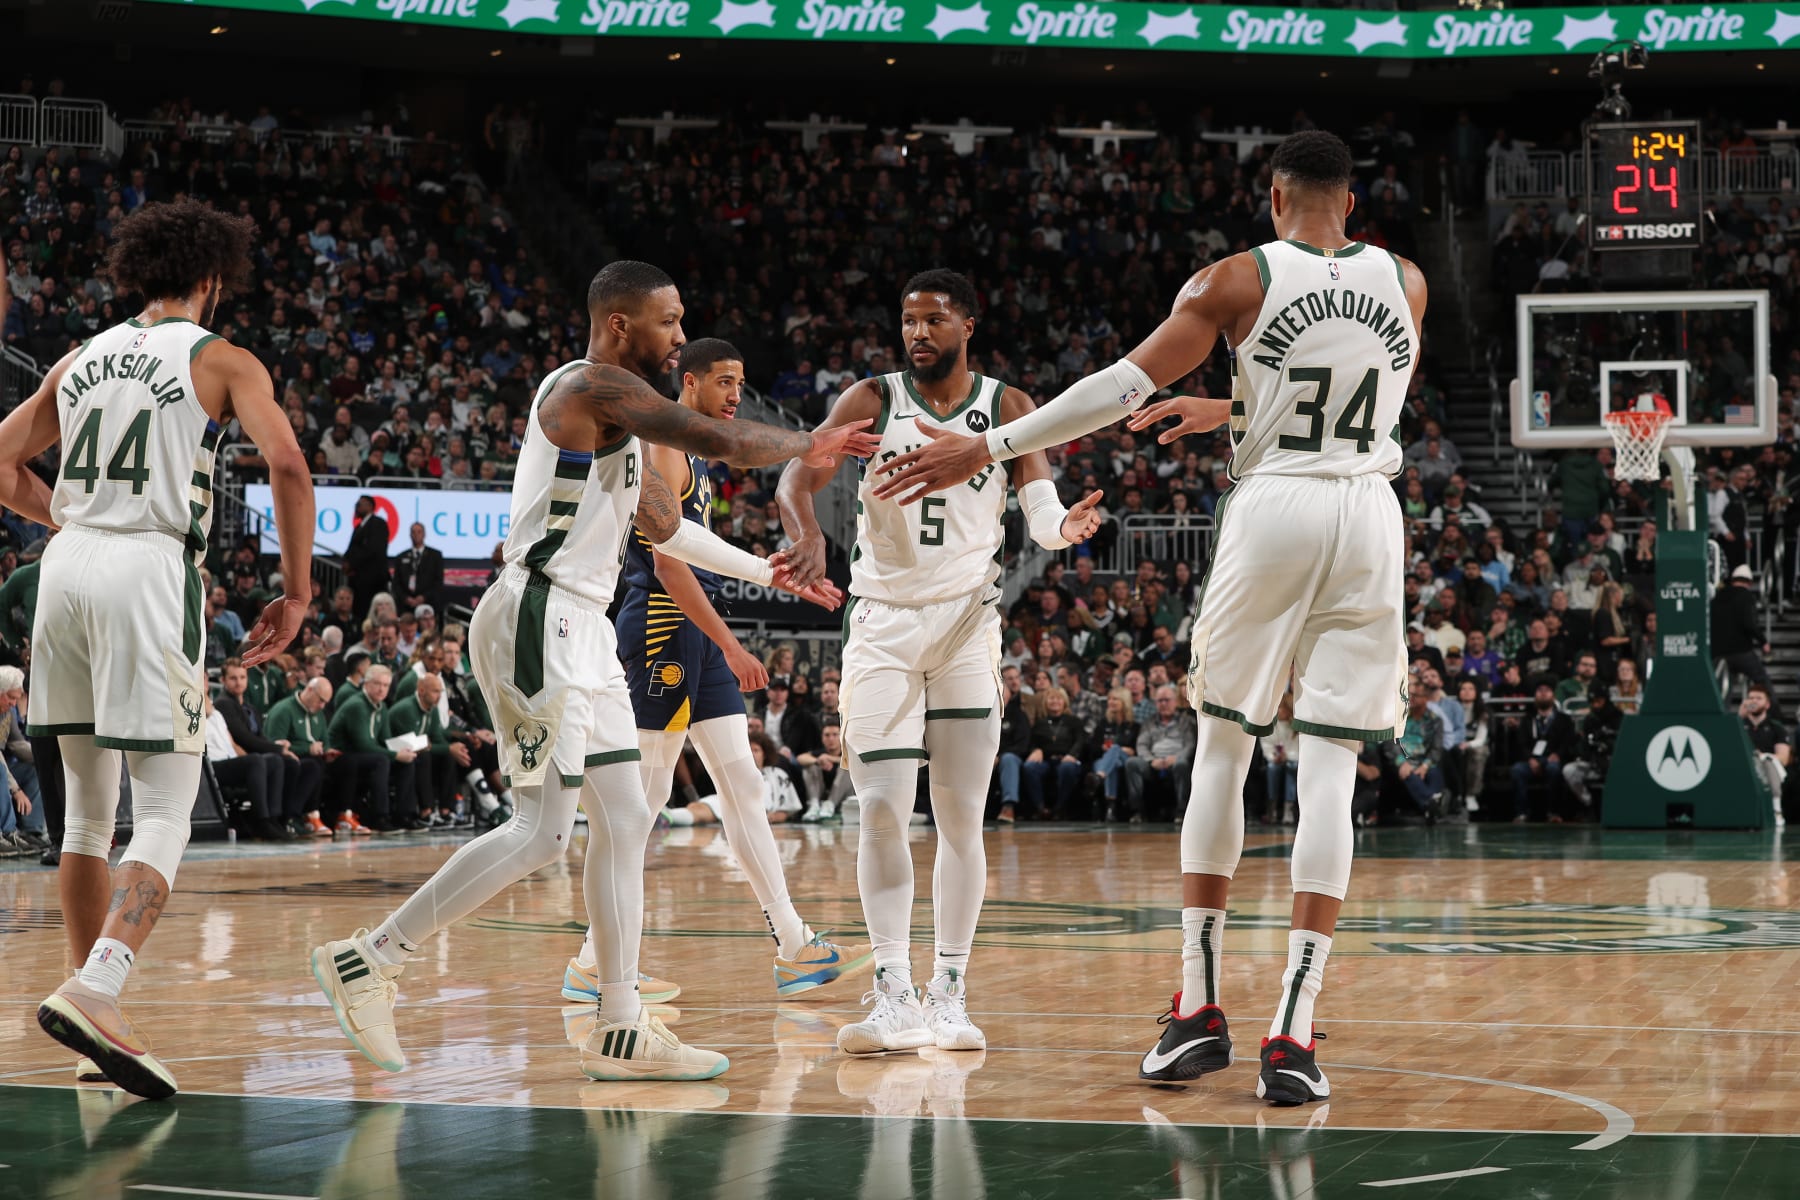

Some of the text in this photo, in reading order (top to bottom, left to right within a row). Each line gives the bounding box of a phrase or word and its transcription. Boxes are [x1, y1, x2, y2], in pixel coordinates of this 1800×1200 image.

[581, 0, 689, 33] Sprite
[797, 0, 905, 38] Sprite
[1010, 2, 1117, 43] Sprite
[1221, 9, 1325, 50] Sprite
[1428, 12, 1533, 55] Sprite
[1638, 6, 1744, 49] Sprite
[1632, 131, 1686, 161] 1:24
[1612, 164, 1679, 214] 24
[1624, 222, 1696, 240] TISSOT
[1253, 288, 1411, 372] ANTETOKOUNMPO
[60, 352, 186, 410] JACKSON JR
[1277, 366, 1381, 454] 34
[62, 407, 153, 496] 44
[432, 511, 511, 538] CLUB
[919, 496, 947, 546] 5
[1660, 588, 1700, 600] ULTRA
